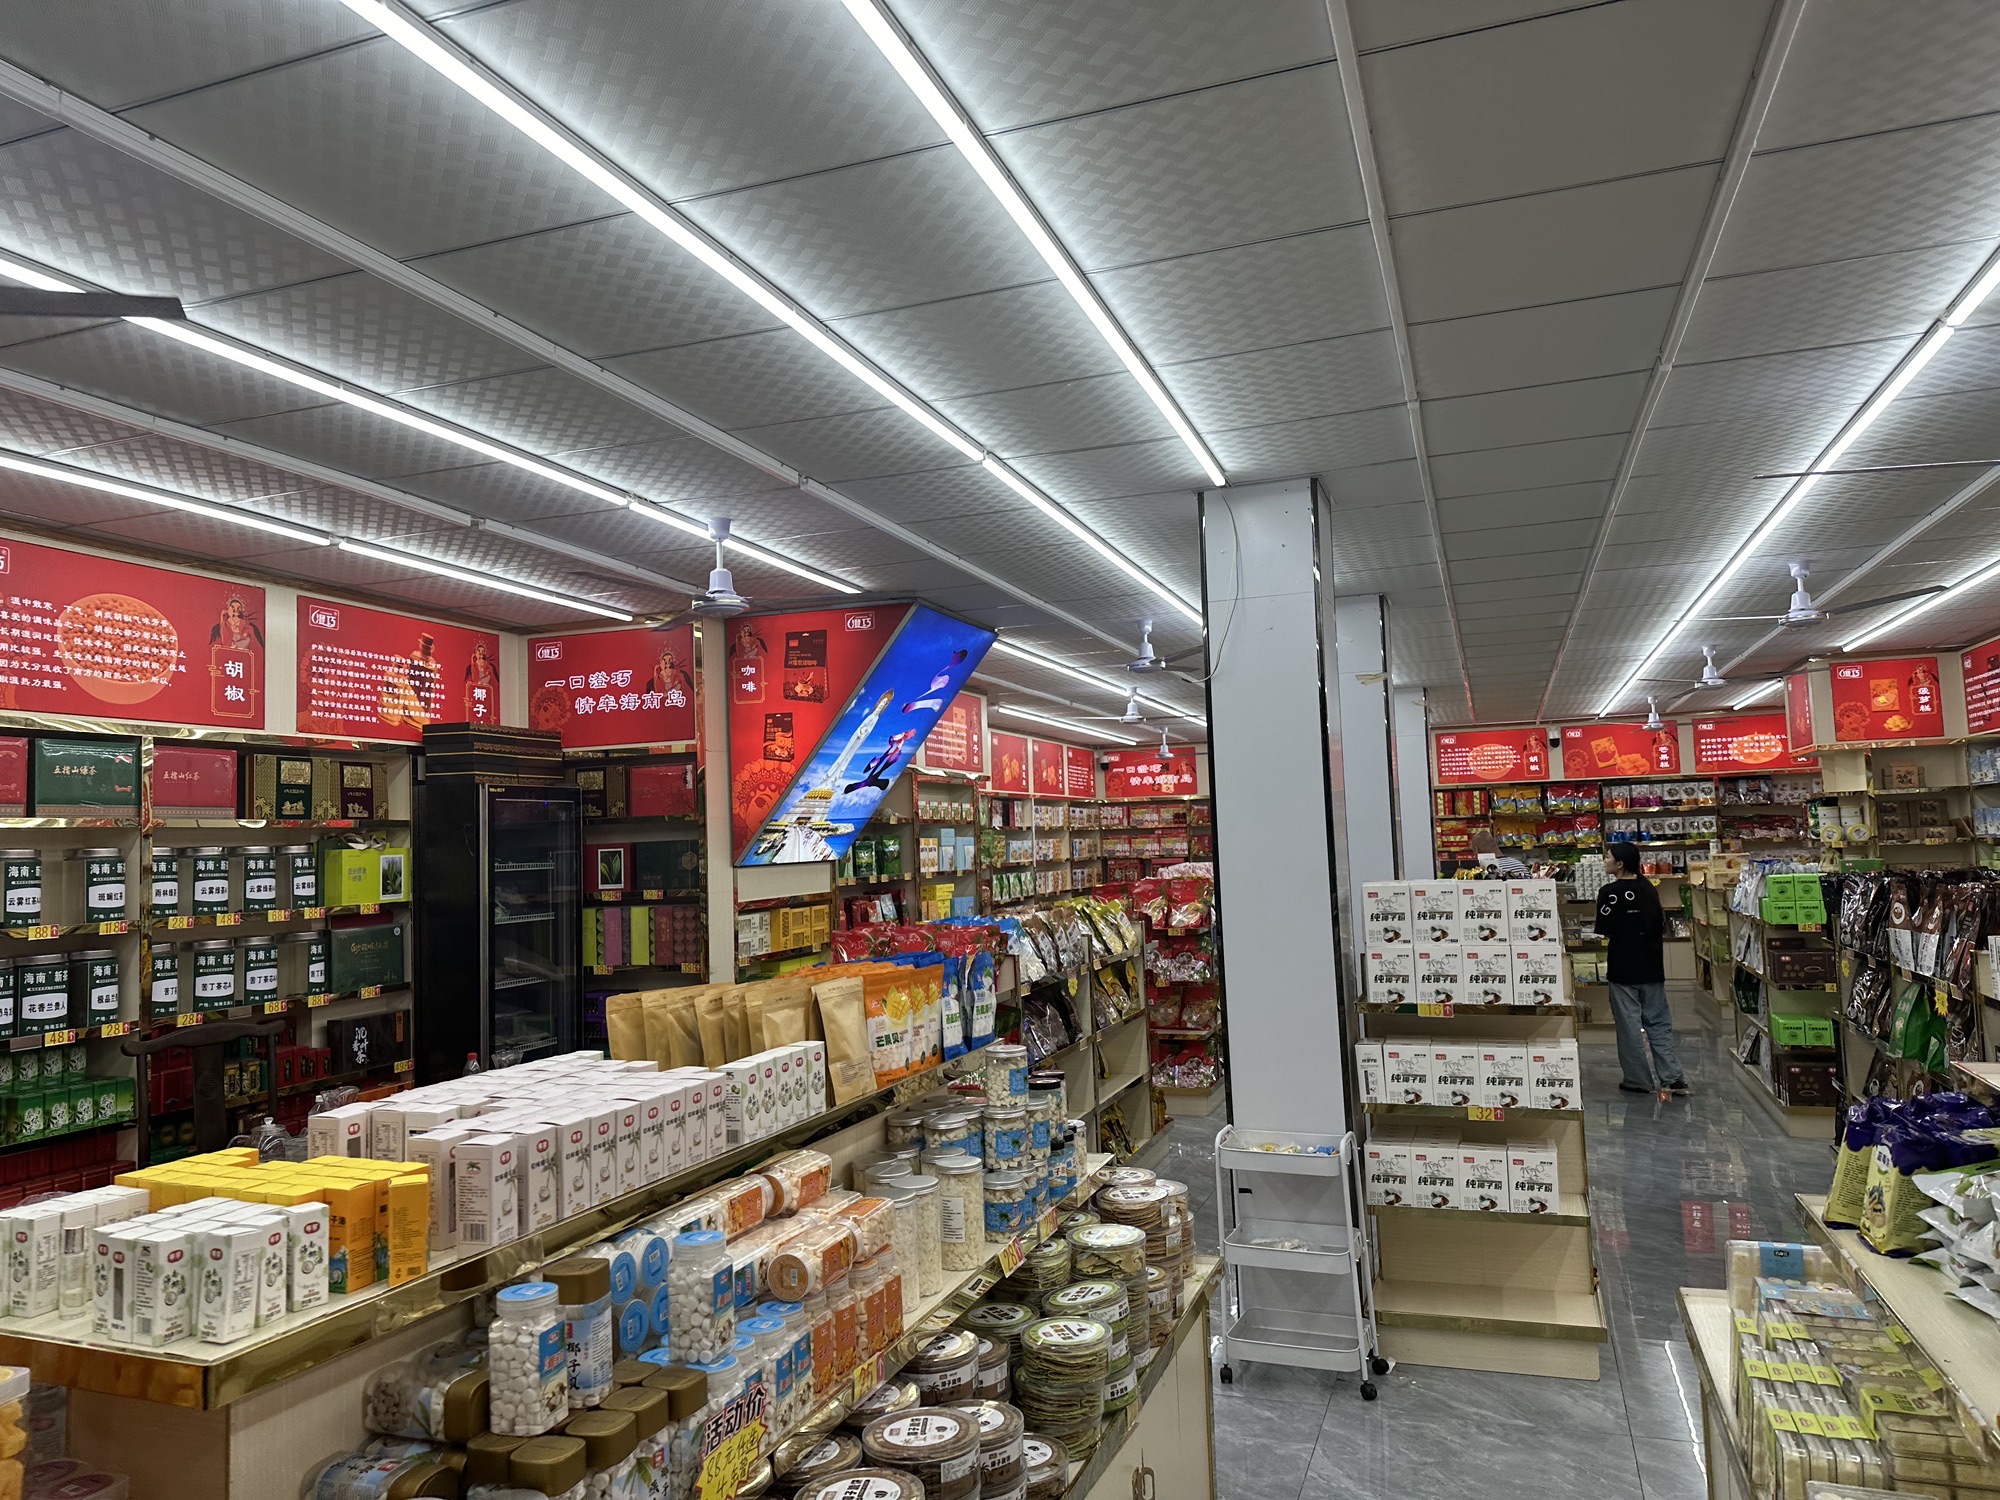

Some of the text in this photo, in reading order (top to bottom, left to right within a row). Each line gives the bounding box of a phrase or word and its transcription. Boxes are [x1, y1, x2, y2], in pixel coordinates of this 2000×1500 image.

[224, 660, 246, 702] 胡椒
[545, 670, 632, 690] 一口澄巧
[741, 665, 757, 693] 咖啡
[473, 686, 488, 723] 椰子
[575, 689, 686, 715] 情牵海南岛
[294, 858, 315, 868] 海南·
[220, 914, 233, 925] 48
[272, 910, 283, 921] 68
[309, 908, 318, 918] 88
[105, 921, 120, 934] 118
[172, 917, 185, 928] 28
[35, 926, 48, 939] 88
[154, 958, 178, 971] 海南·
[28, 1000, 66, 1014] 花香兰贵人
[268, 1002, 280, 1012] 68
[1426, 1003, 1442, 1017] 16
[182, 1014, 194, 1026] 28
[107, 1023, 120, 1036] 28
[50, 1031, 65, 1044] 48
[875, 1032, 899, 1048] 芒果贝
[1476, 1107, 1492, 1120] 32
[1002, 1246, 1018, 1275] 28
[566, 1341, 581, 1391] 椰子贝
[705, 1387, 765, 1457] 活动价
